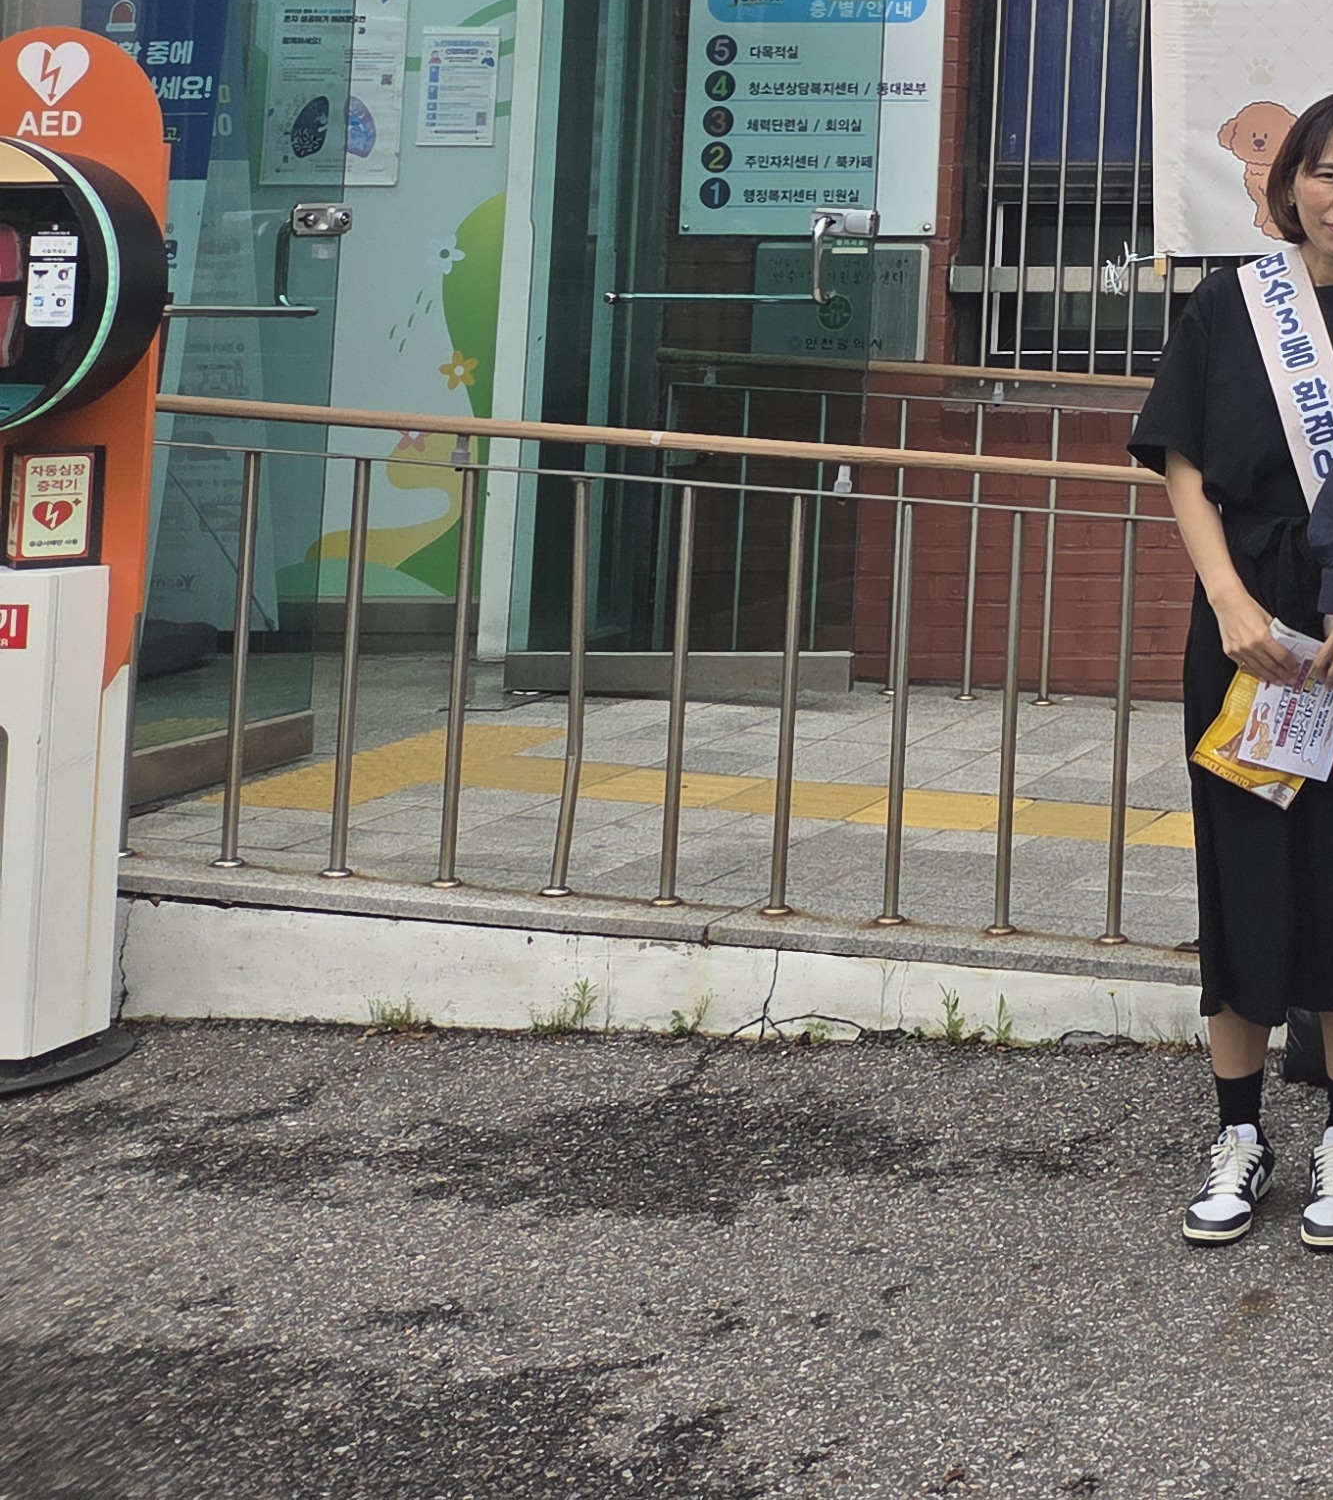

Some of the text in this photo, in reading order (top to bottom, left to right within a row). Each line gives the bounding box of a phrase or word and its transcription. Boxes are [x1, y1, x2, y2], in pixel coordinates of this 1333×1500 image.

[146, 41, 194, 64] 중에
[714, 39, 799, 61] 5 다목적실
[153, 76, 212, 100] 세요!
[712, 75, 728, 97] 4
[749, 82, 859, 95] 청소년상담복지센터
[16, 111, 83, 137] AED
[710, 111, 862, 133] 3 체력단련실 회의실
[708, 146, 725, 169] 2
[744, 155, 819, 169] 주민자치센터
[709, 182, 860, 205] 1 행정복지센터 민원실
[30, 464, 86, 477] 자동심장
[36, 479, 78, 492] 충격기
